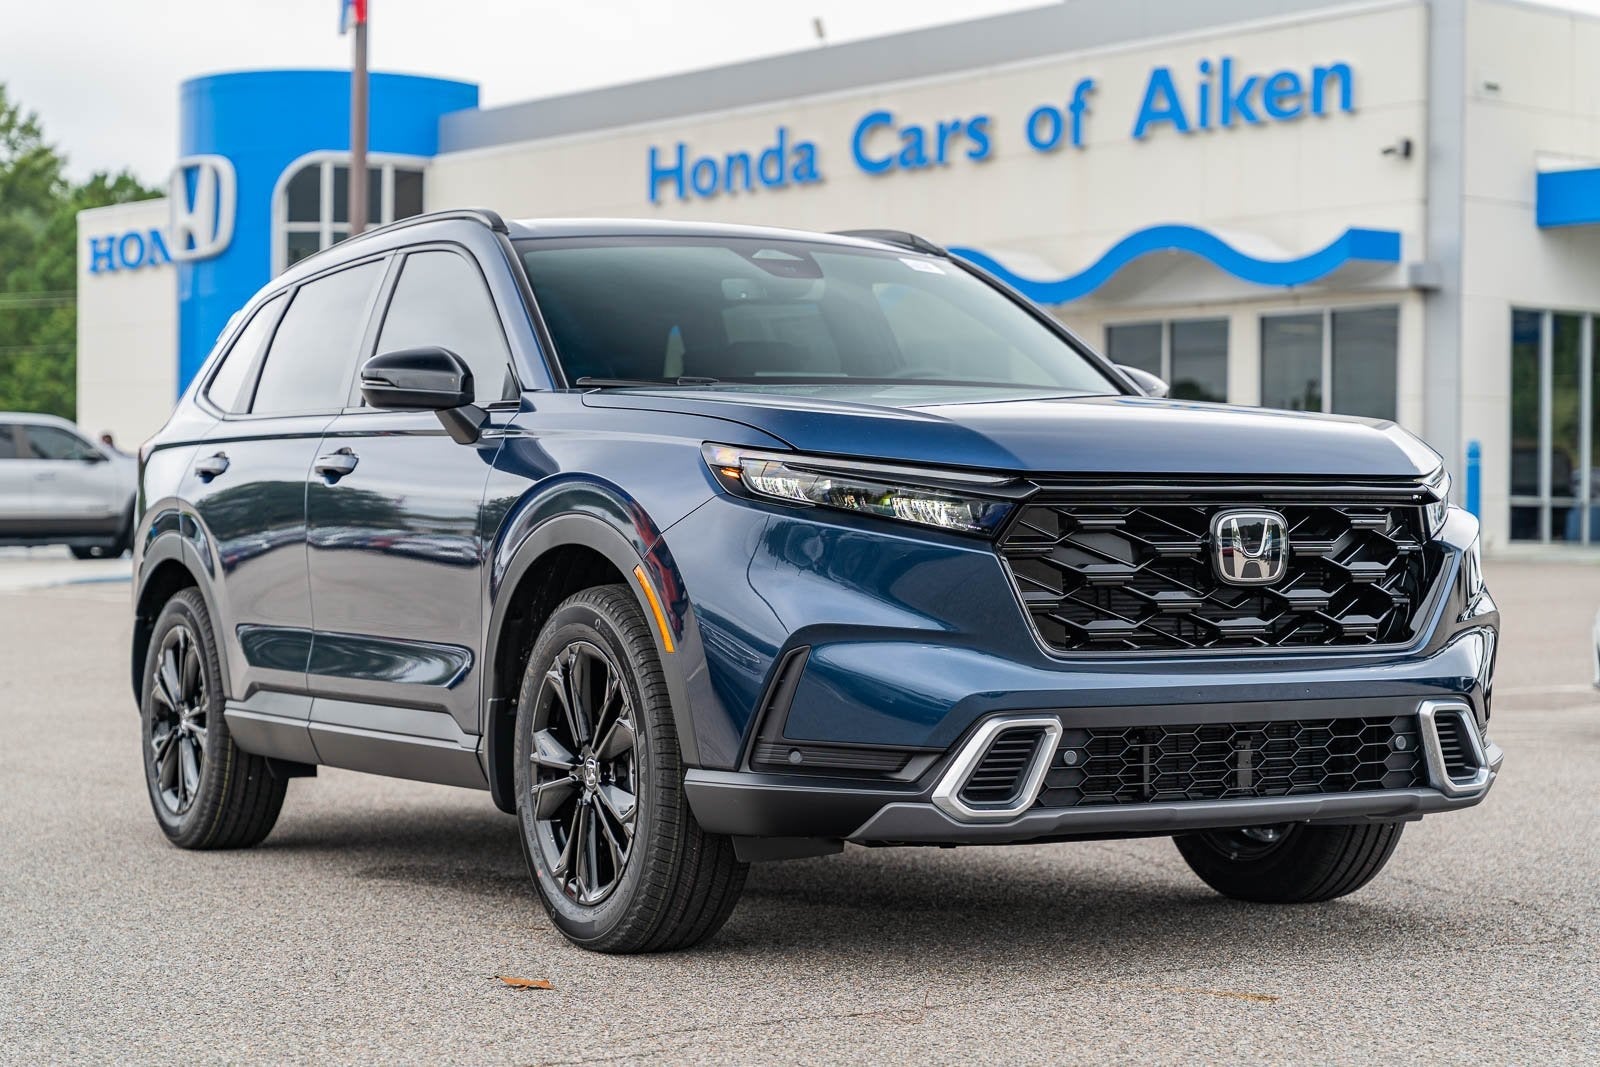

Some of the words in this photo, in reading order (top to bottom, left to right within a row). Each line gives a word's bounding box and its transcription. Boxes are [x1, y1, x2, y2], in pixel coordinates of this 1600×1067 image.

[648, 126, 822, 204] Honda
[849, 109, 992, 176] Cars
[1025, 76, 1095, 153] of
[1131, 56, 1355, 140] Aiken
